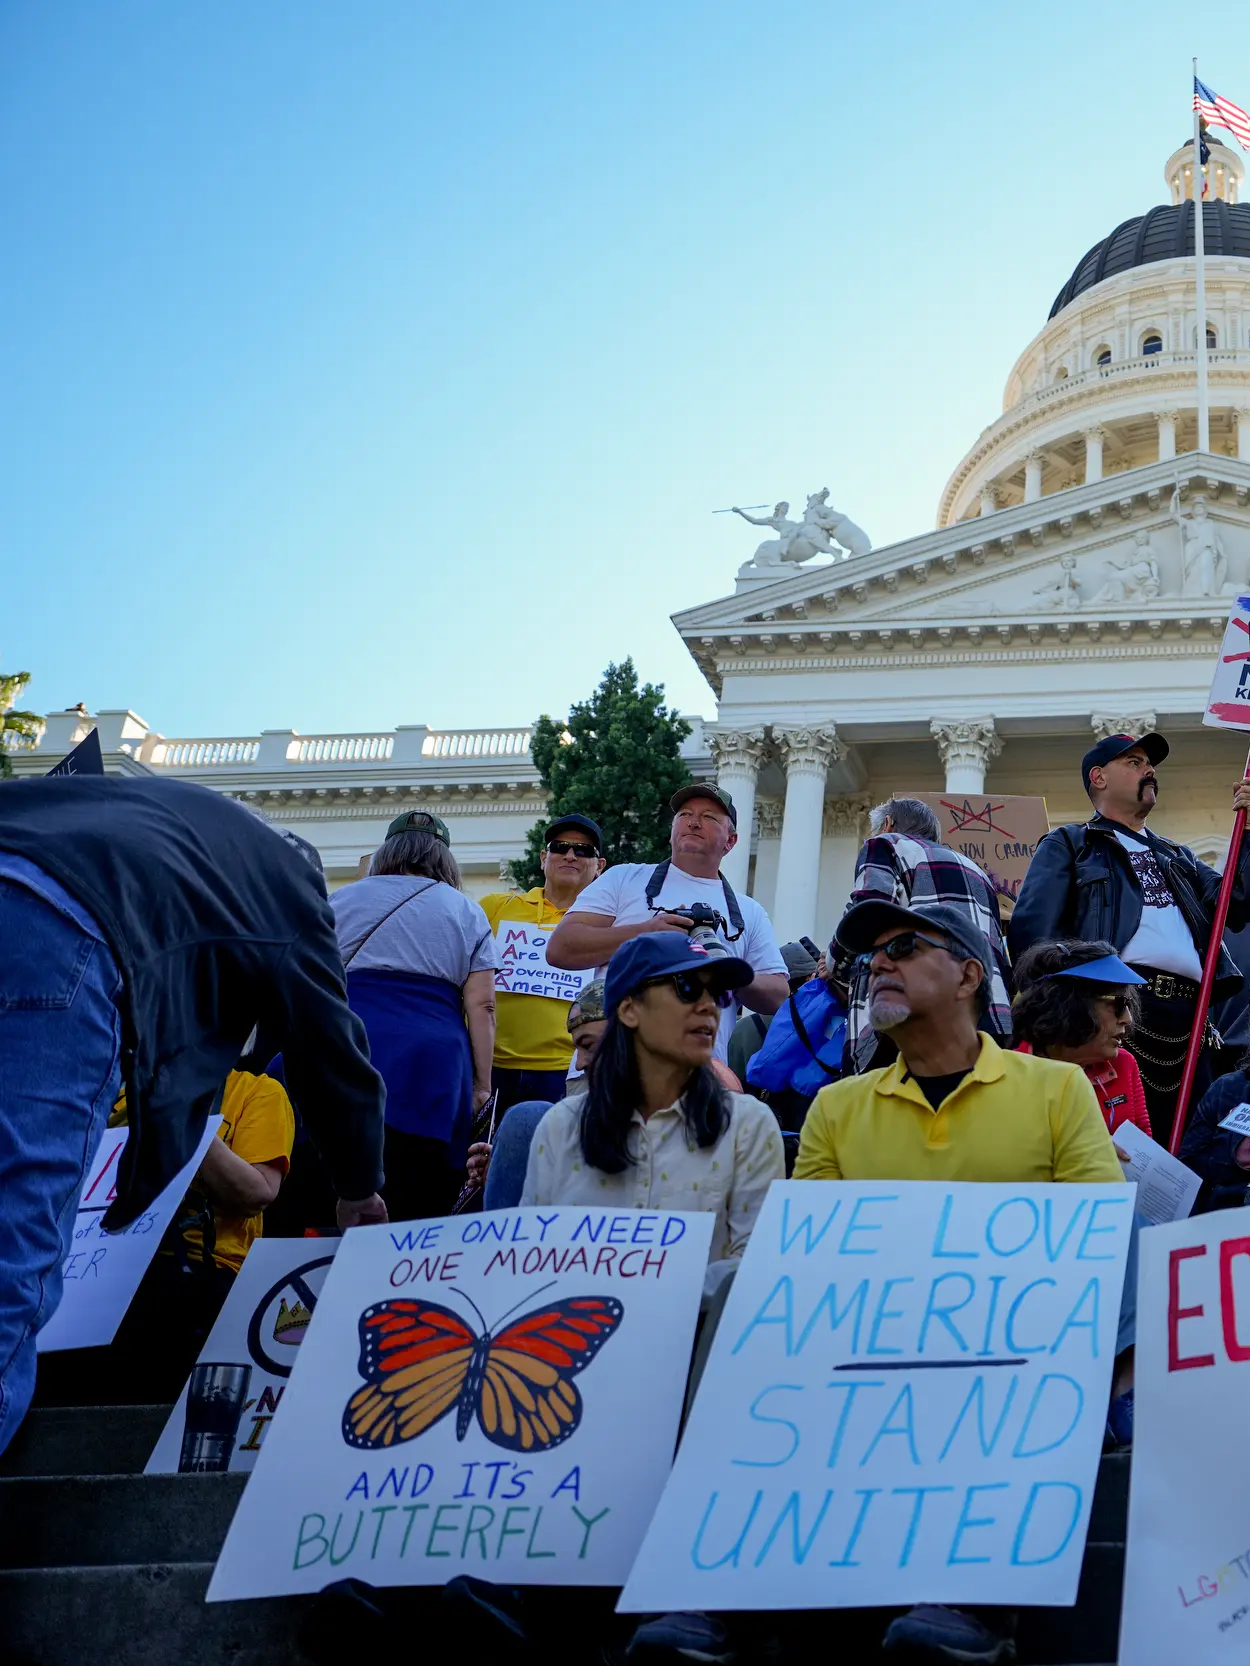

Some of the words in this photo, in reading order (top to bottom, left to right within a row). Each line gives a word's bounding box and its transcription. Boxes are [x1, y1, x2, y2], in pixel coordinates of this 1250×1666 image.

[501, 943, 540, 961] Are
[500, 960, 582, 988] Governing
[389, 1225, 440, 1252] WE
[462, 1214, 559, 1246] ONLY
[570, 1215, 687, 1246] NEED
[781, 1195, 899, 1255] WE
[931, 1194, 1129, 1262] LOVE
[390, 1251, 463, 1287] ONE
[484, 1245, 668, 1279] MONARCH
[731, 1271, 1100, 1358] AMERICA
[731, 1373, 1085, 1468] STAND
[346, 1463, 434, 1501] AND
[454, 1461, 533, 1500] IT'S
[551, 1466, 580, 1501] A
[292, 1505, 609, 1570] BUTTERFLY
[690, 1481, 1083, 1569] UNITED
[1217, 1604, 1250, 1633] BLACK
